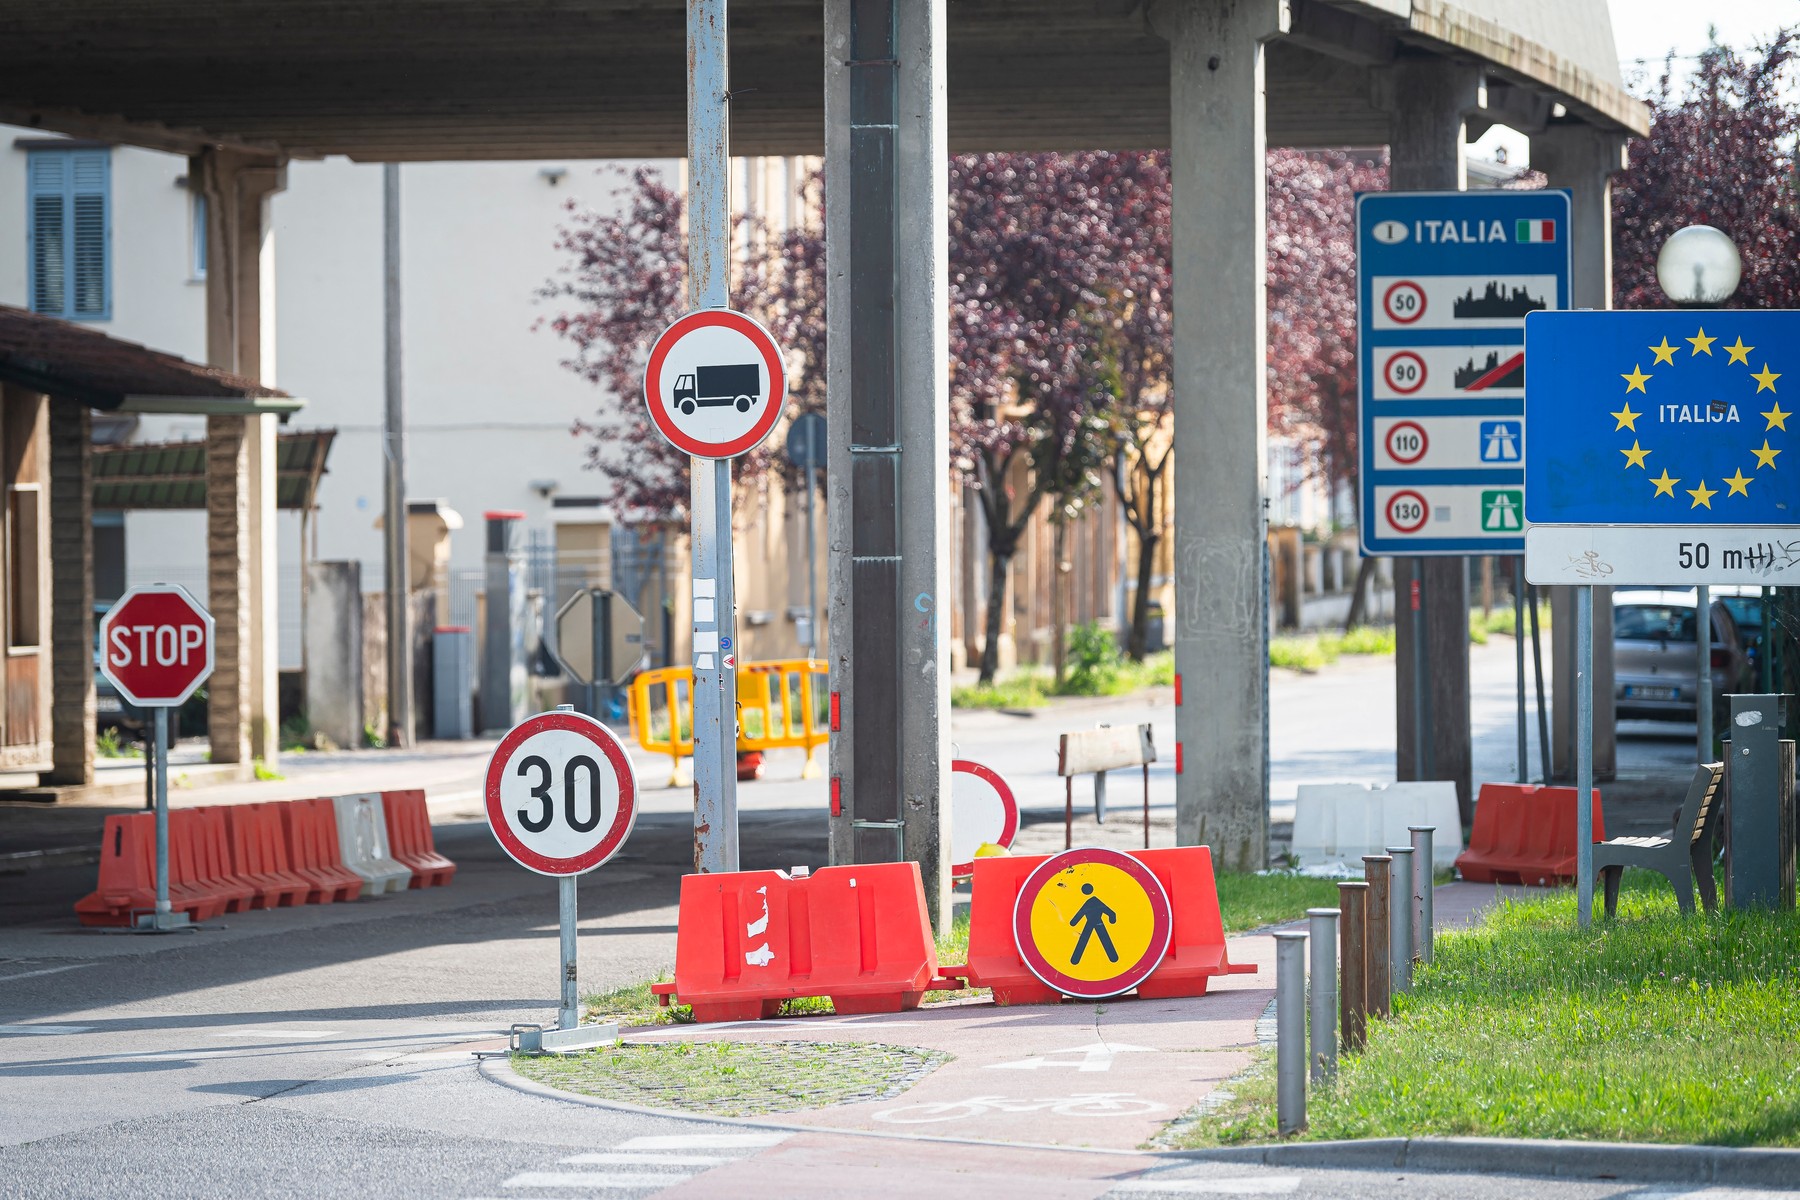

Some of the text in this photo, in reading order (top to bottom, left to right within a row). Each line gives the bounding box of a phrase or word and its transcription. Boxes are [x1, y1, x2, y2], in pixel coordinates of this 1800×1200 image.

[1386, 220, 1507, 243] I ITALIA
[1396, 294, 1416, 311] 50
[1395, 364, 1416, 381] 90
[1396, 434, 1419, 451] 110
[1395, 503, 1420, 520] 130
[1678, 542, 1710, 569] 50
[110, 624, 204, 667] STOP
[517, 754, 601, 834] 30
